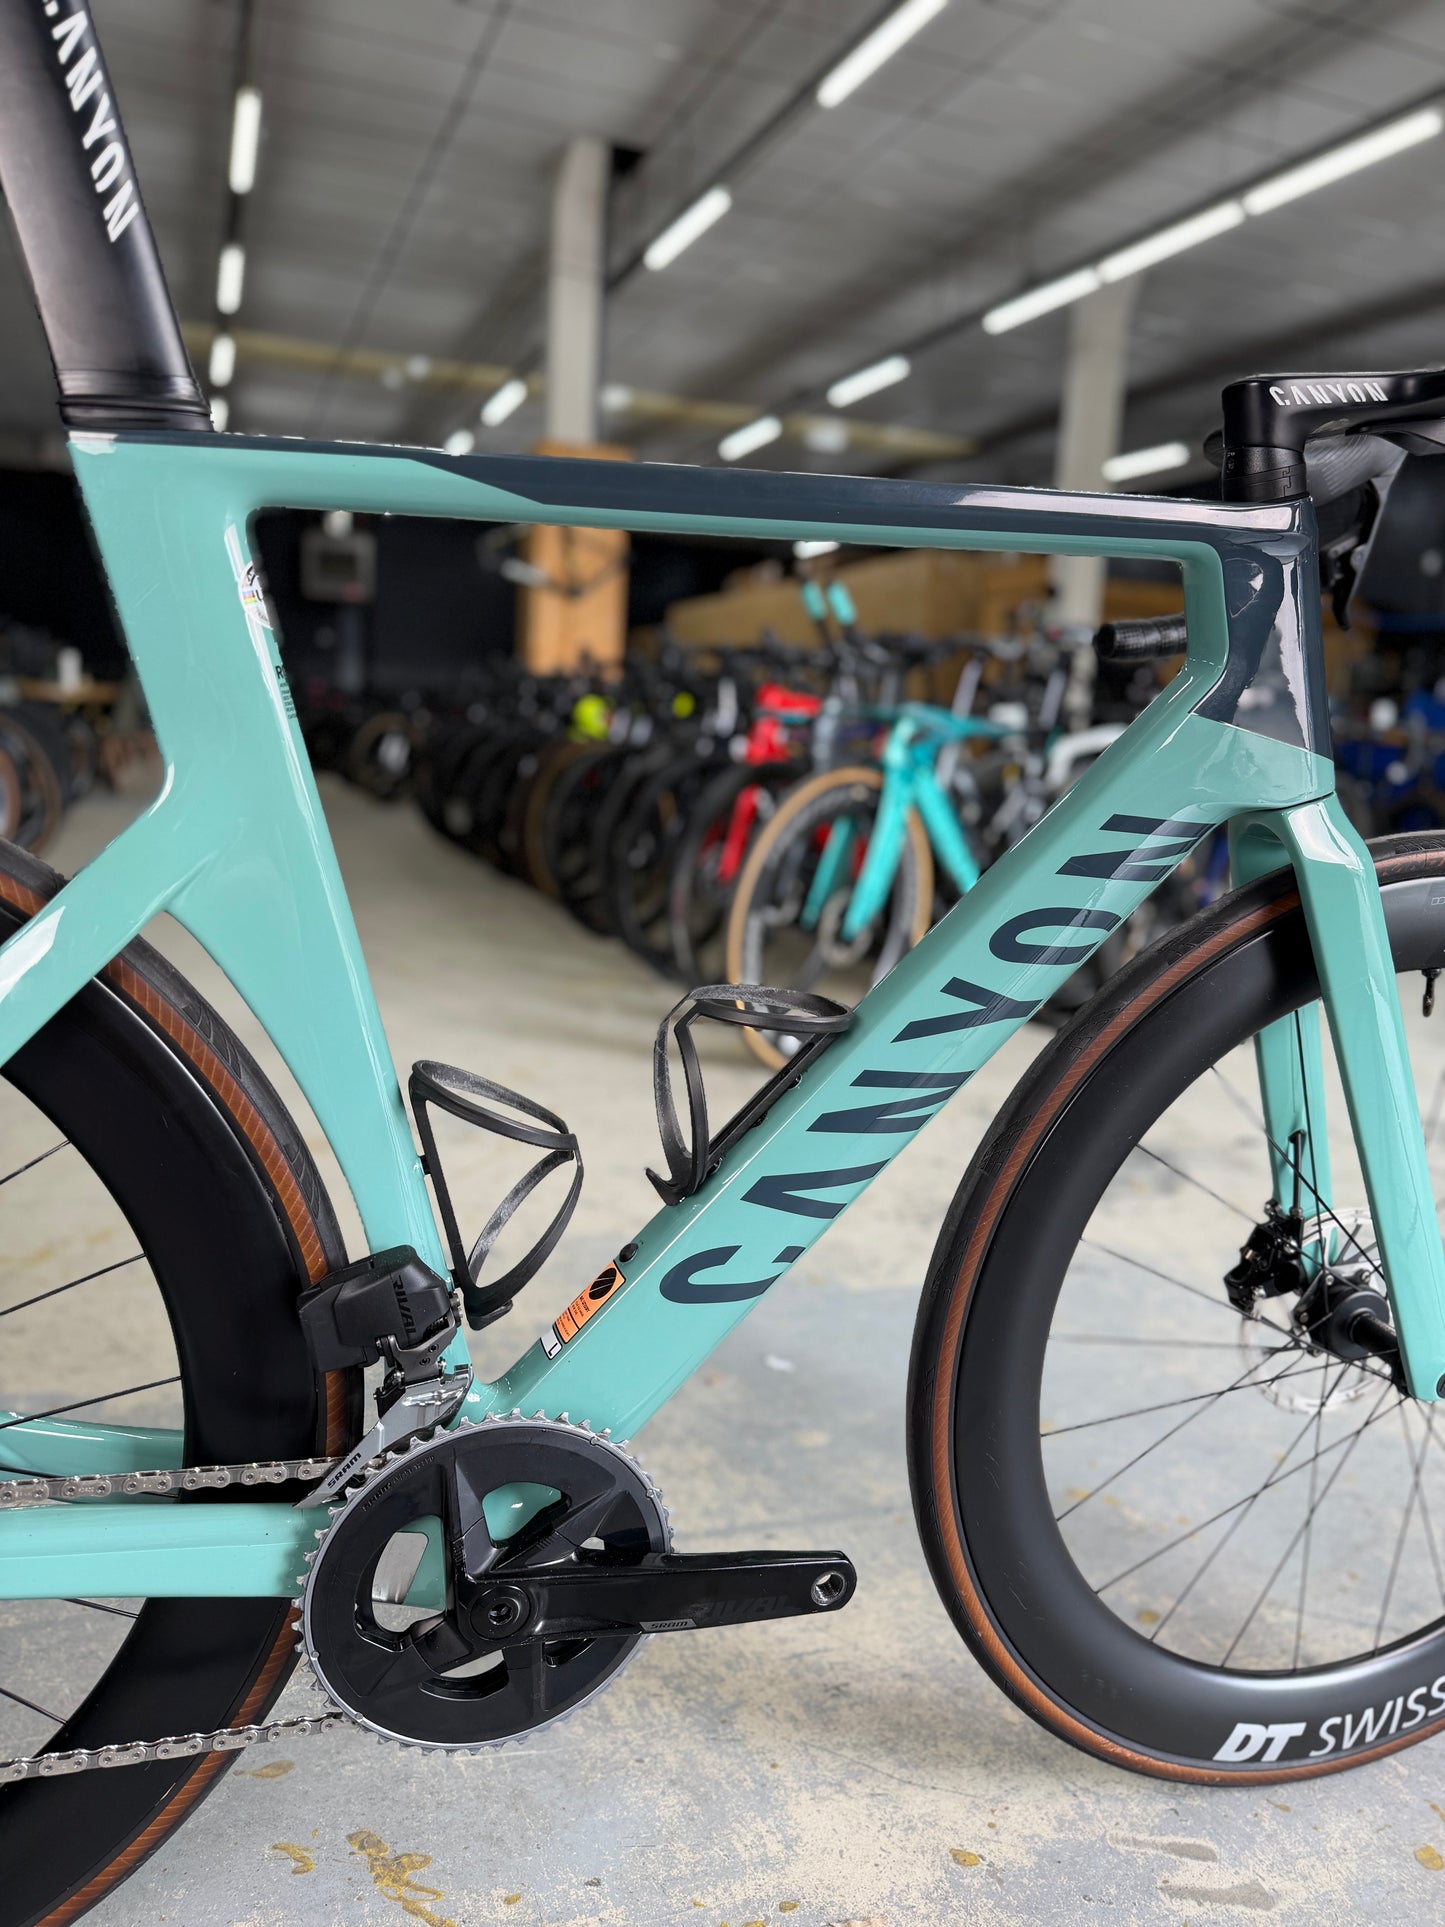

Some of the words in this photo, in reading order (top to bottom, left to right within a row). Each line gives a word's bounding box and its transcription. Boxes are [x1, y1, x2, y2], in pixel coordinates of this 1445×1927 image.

[42, 0, 140, 243] ANYON
[1269, 382, 1389, 406] CANYON
[659, 814, 1217, 1304] CANYON
[391, 1274, 417, 1335] RIVAL
[327, 1452, 362, 1489] SRAM
[651, 1621, 688, 1629] SRAM
[1212, 1722, 1307, 1762] DT
[1309, 1675, 1445, 1757] SWISS
